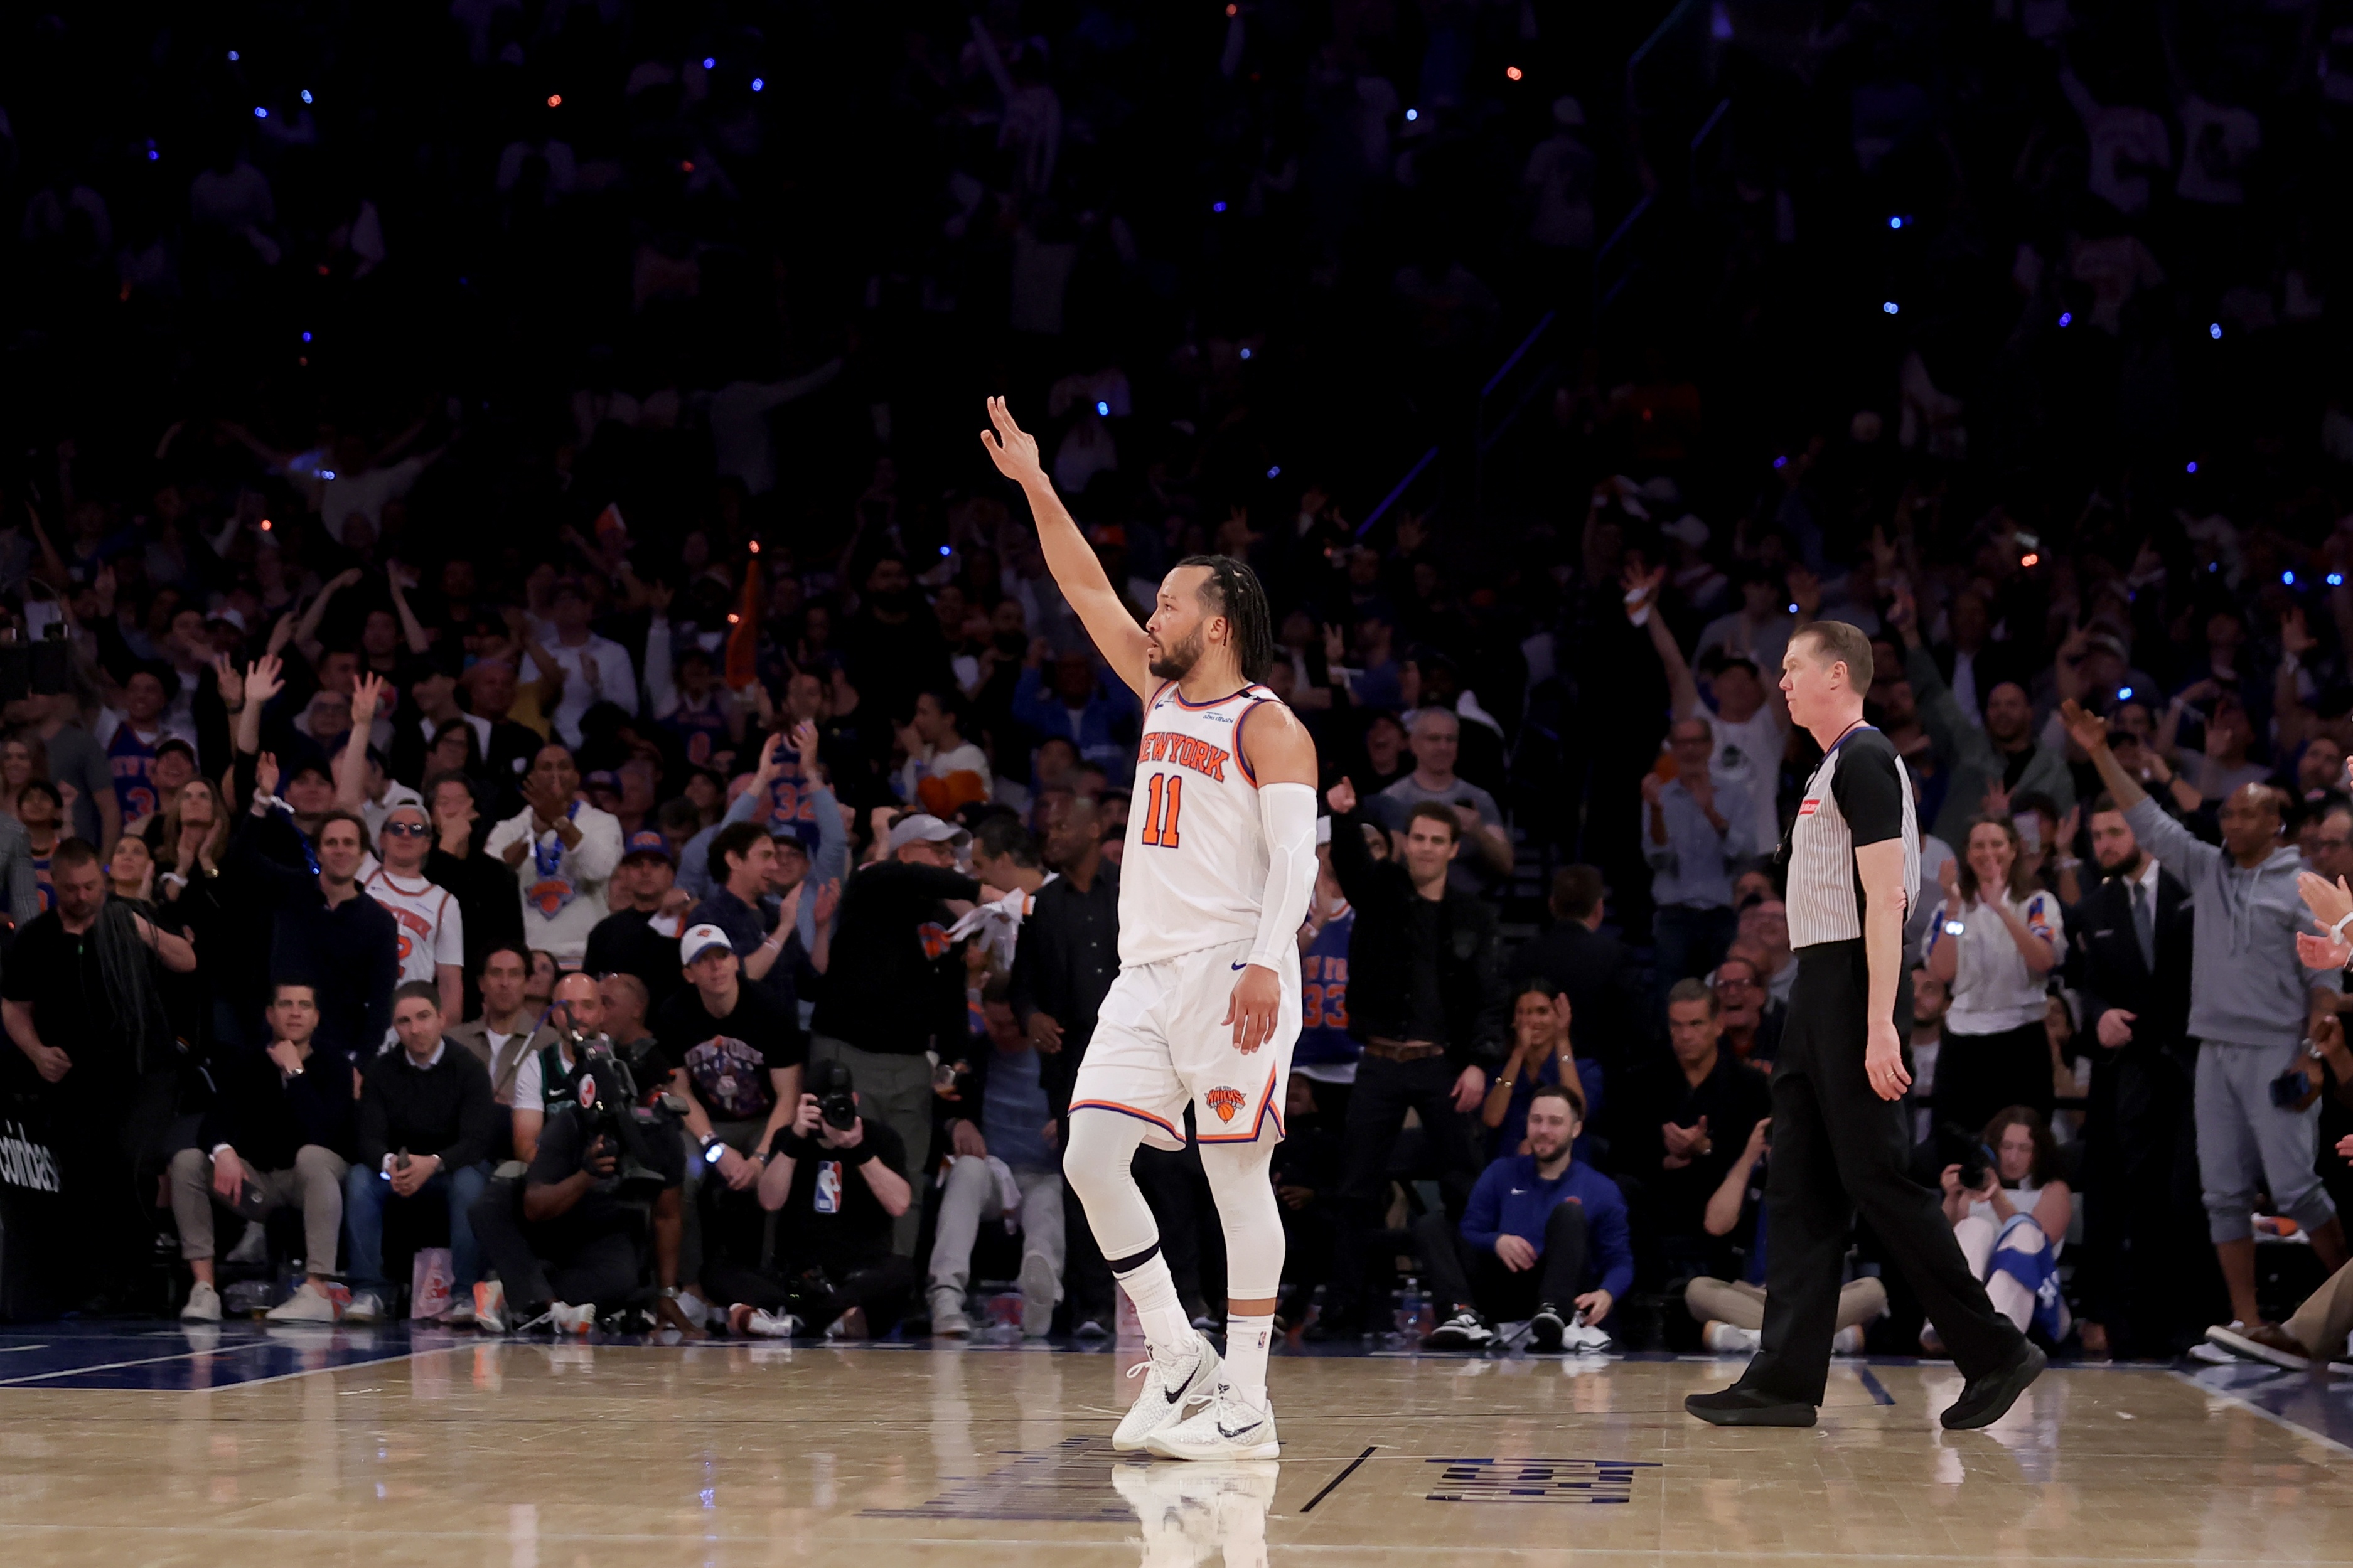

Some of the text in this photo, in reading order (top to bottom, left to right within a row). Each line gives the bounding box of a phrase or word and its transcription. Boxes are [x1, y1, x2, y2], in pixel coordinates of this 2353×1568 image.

[1138, 732, 1230, 784] EW YORK
[1142, 772, 1182, 849] 11
[1303, 983, 1350, 1029] 33
[1206, 1089, 1246, 1109] KNICKS
[0, 1118, 62, 1193] coinbas
